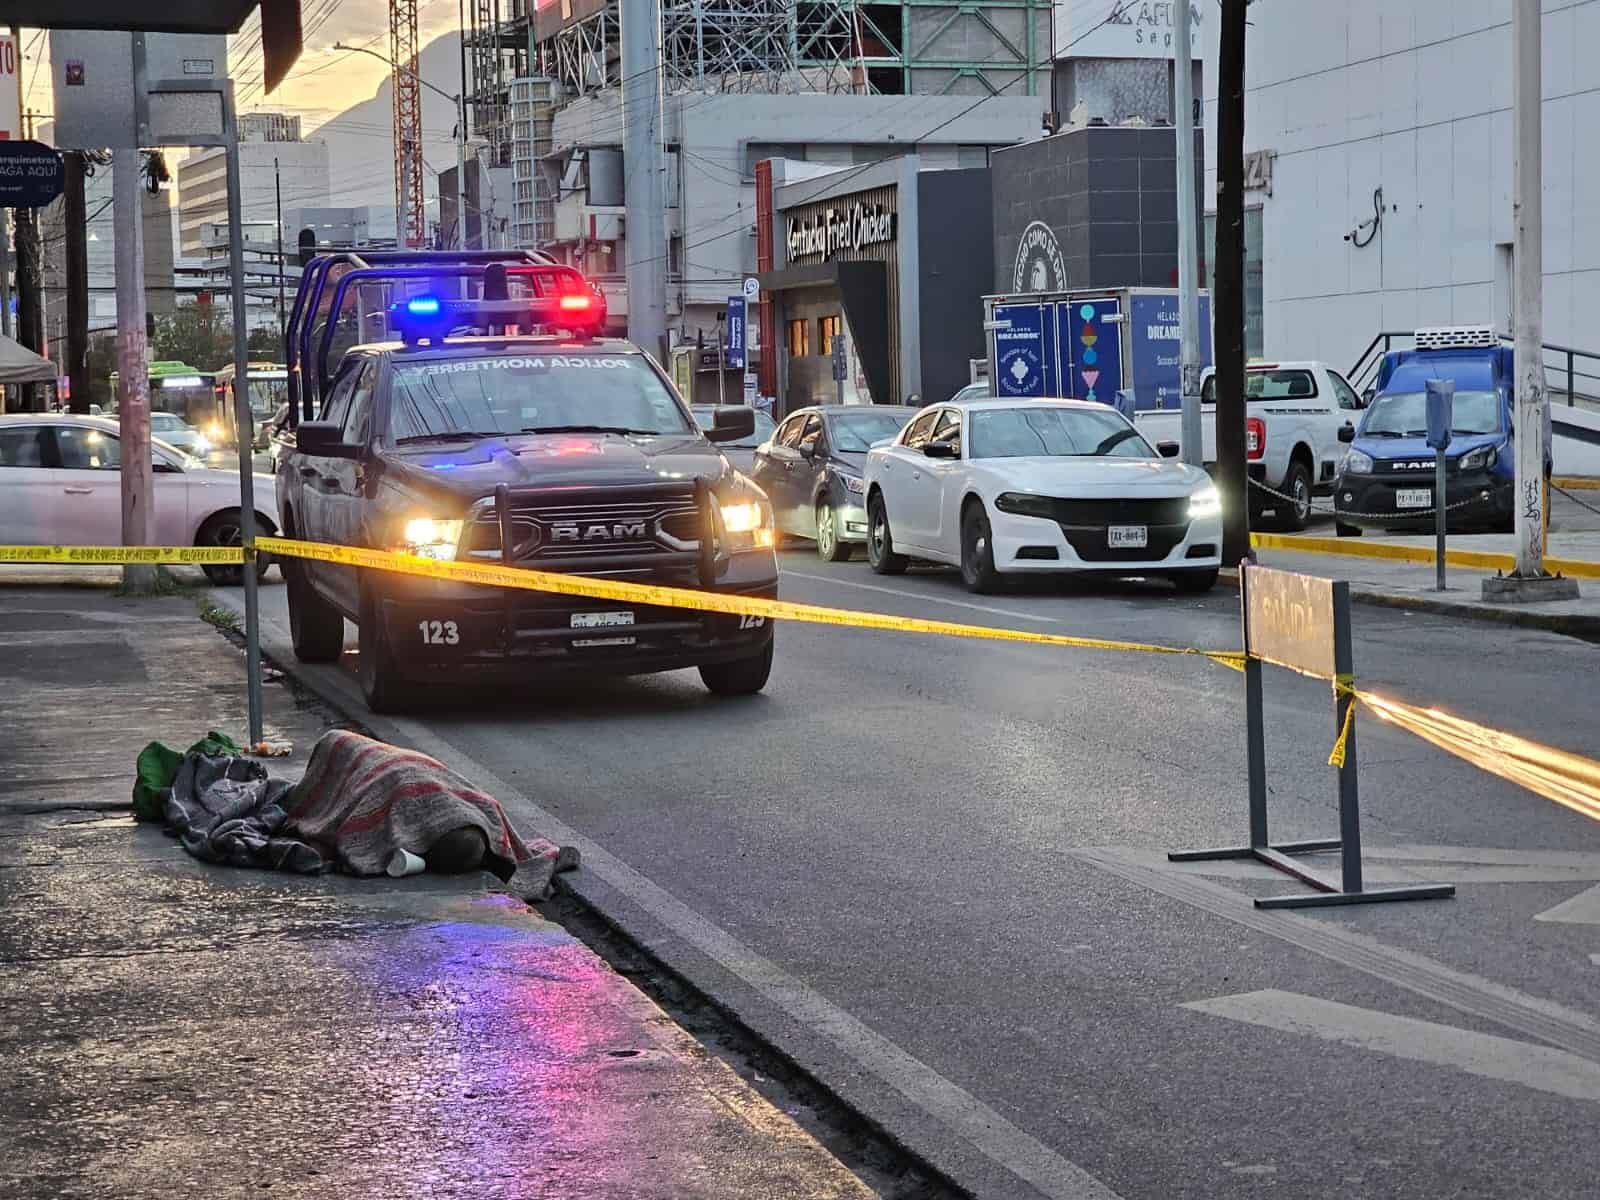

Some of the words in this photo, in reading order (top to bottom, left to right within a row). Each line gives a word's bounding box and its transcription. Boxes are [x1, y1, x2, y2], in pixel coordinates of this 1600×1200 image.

[786, 215, 826, 263] Kentucky
[826, 206, 851, 256] Fried
[852, 201, 892, 252] Chicken
[1392, 461, 1436, 469] RAM
[551, 522, 646, 542] RAM
[419, 620, 460, 645] 123
